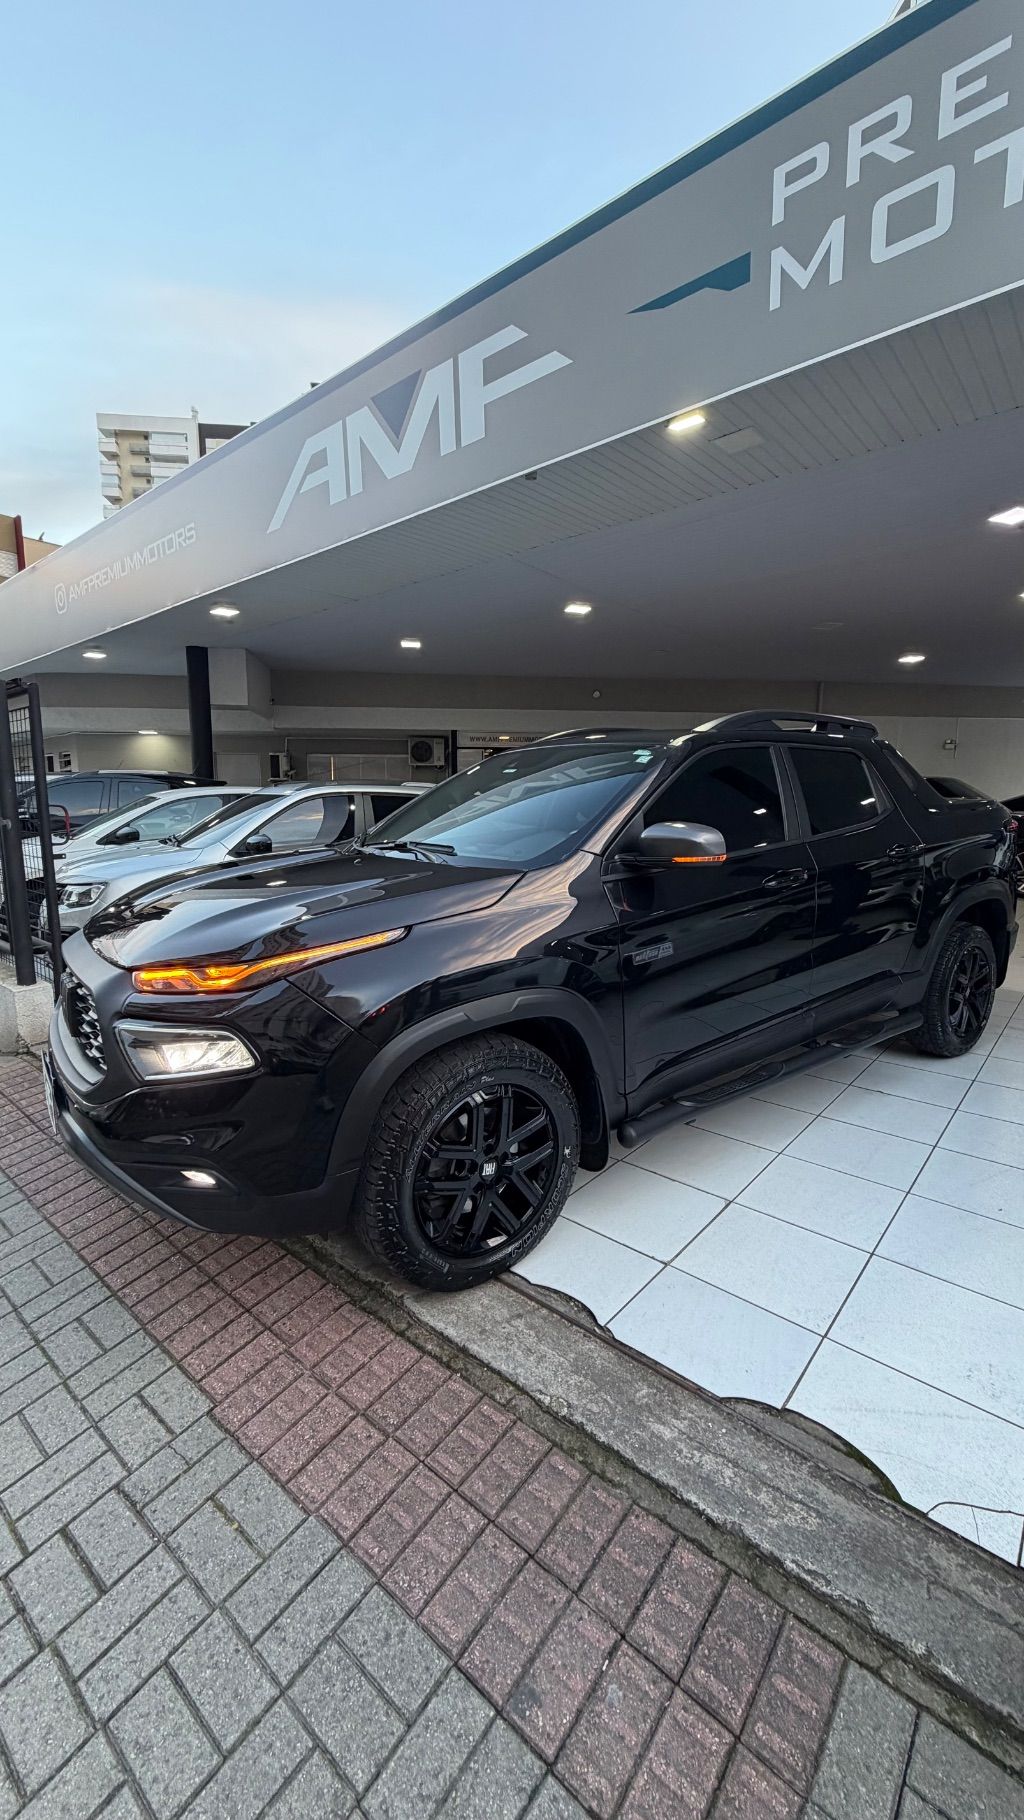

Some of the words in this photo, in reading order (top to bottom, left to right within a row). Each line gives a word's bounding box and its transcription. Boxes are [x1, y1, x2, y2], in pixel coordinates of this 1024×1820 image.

[771, 34, 1013, 228] PRE
[266, 324, 574, 534] AMF
[68, 522, 197, 603] AMFPREMIUMMOTORS
